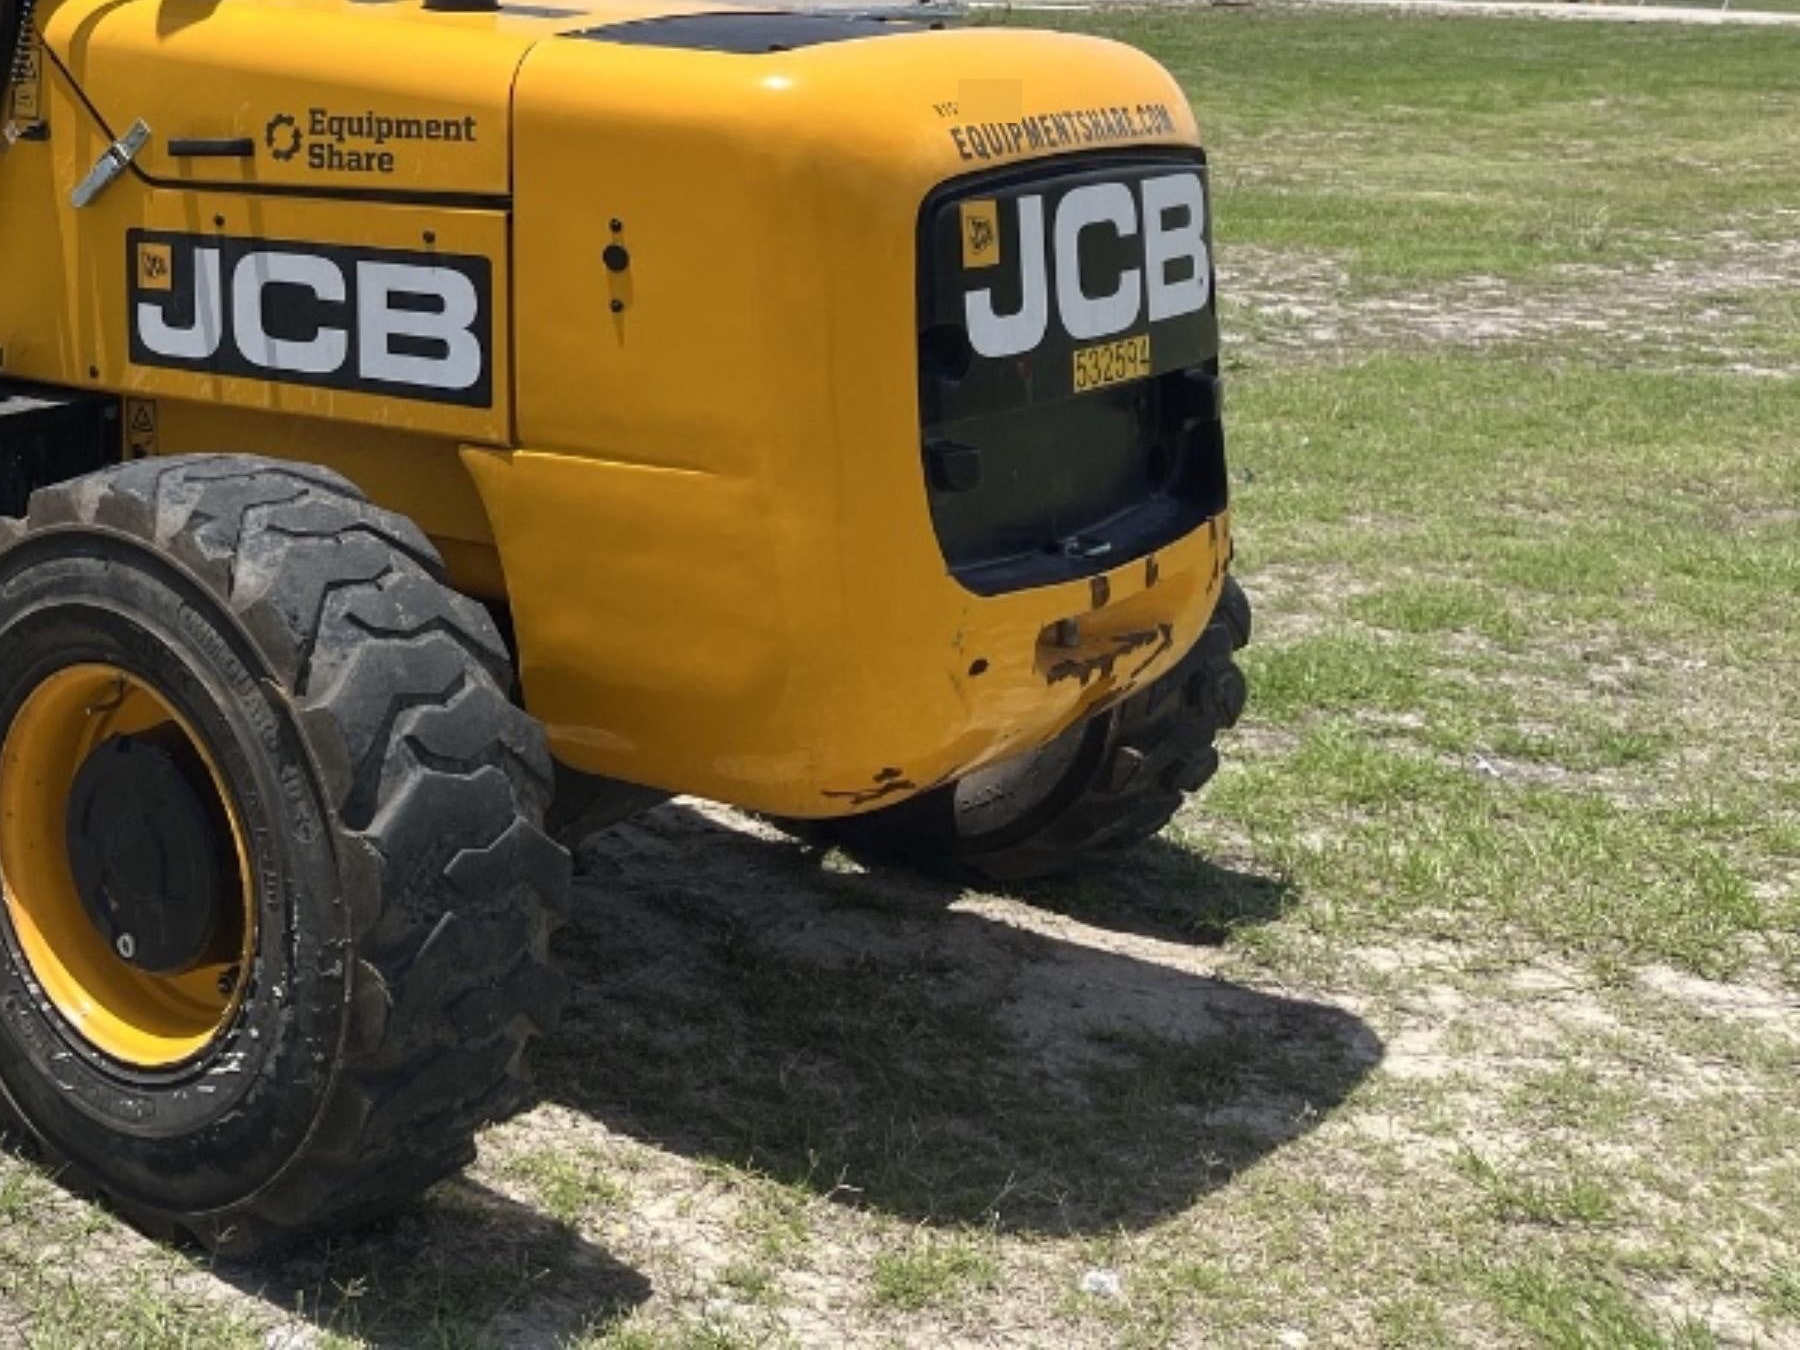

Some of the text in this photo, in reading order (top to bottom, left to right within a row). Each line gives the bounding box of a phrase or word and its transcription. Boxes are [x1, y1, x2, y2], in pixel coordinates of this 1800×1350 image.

[308, 107, 477, 143] Equipment
[308, 143, 395, 173] Share
[963, 172, 1210, 360] JCB
[137, 246, 482, 390] JCB
